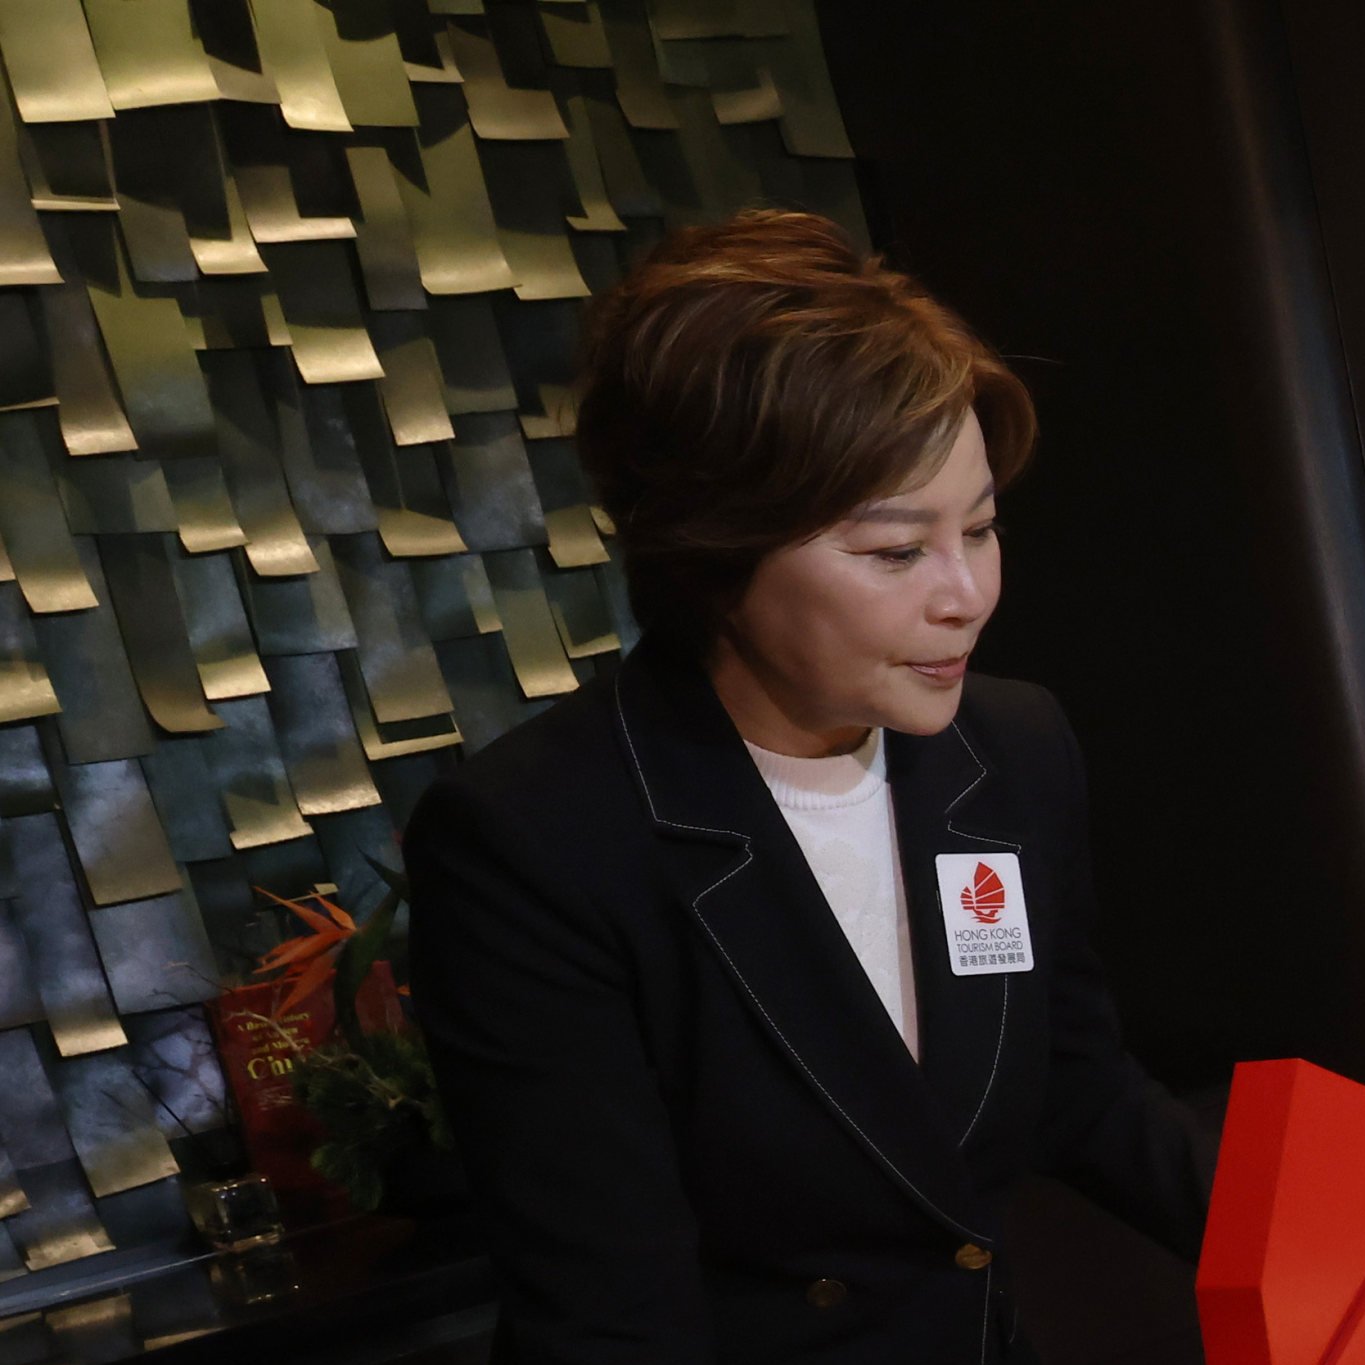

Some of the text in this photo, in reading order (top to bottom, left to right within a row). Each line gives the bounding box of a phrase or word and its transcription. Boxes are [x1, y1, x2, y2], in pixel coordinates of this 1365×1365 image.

[954, 927, 1021, 942] HONG KONG
[956, 940, 1023, 953] TOURISM BOARD
[959, 952, 1025, 967] 香港旅遊發展局
